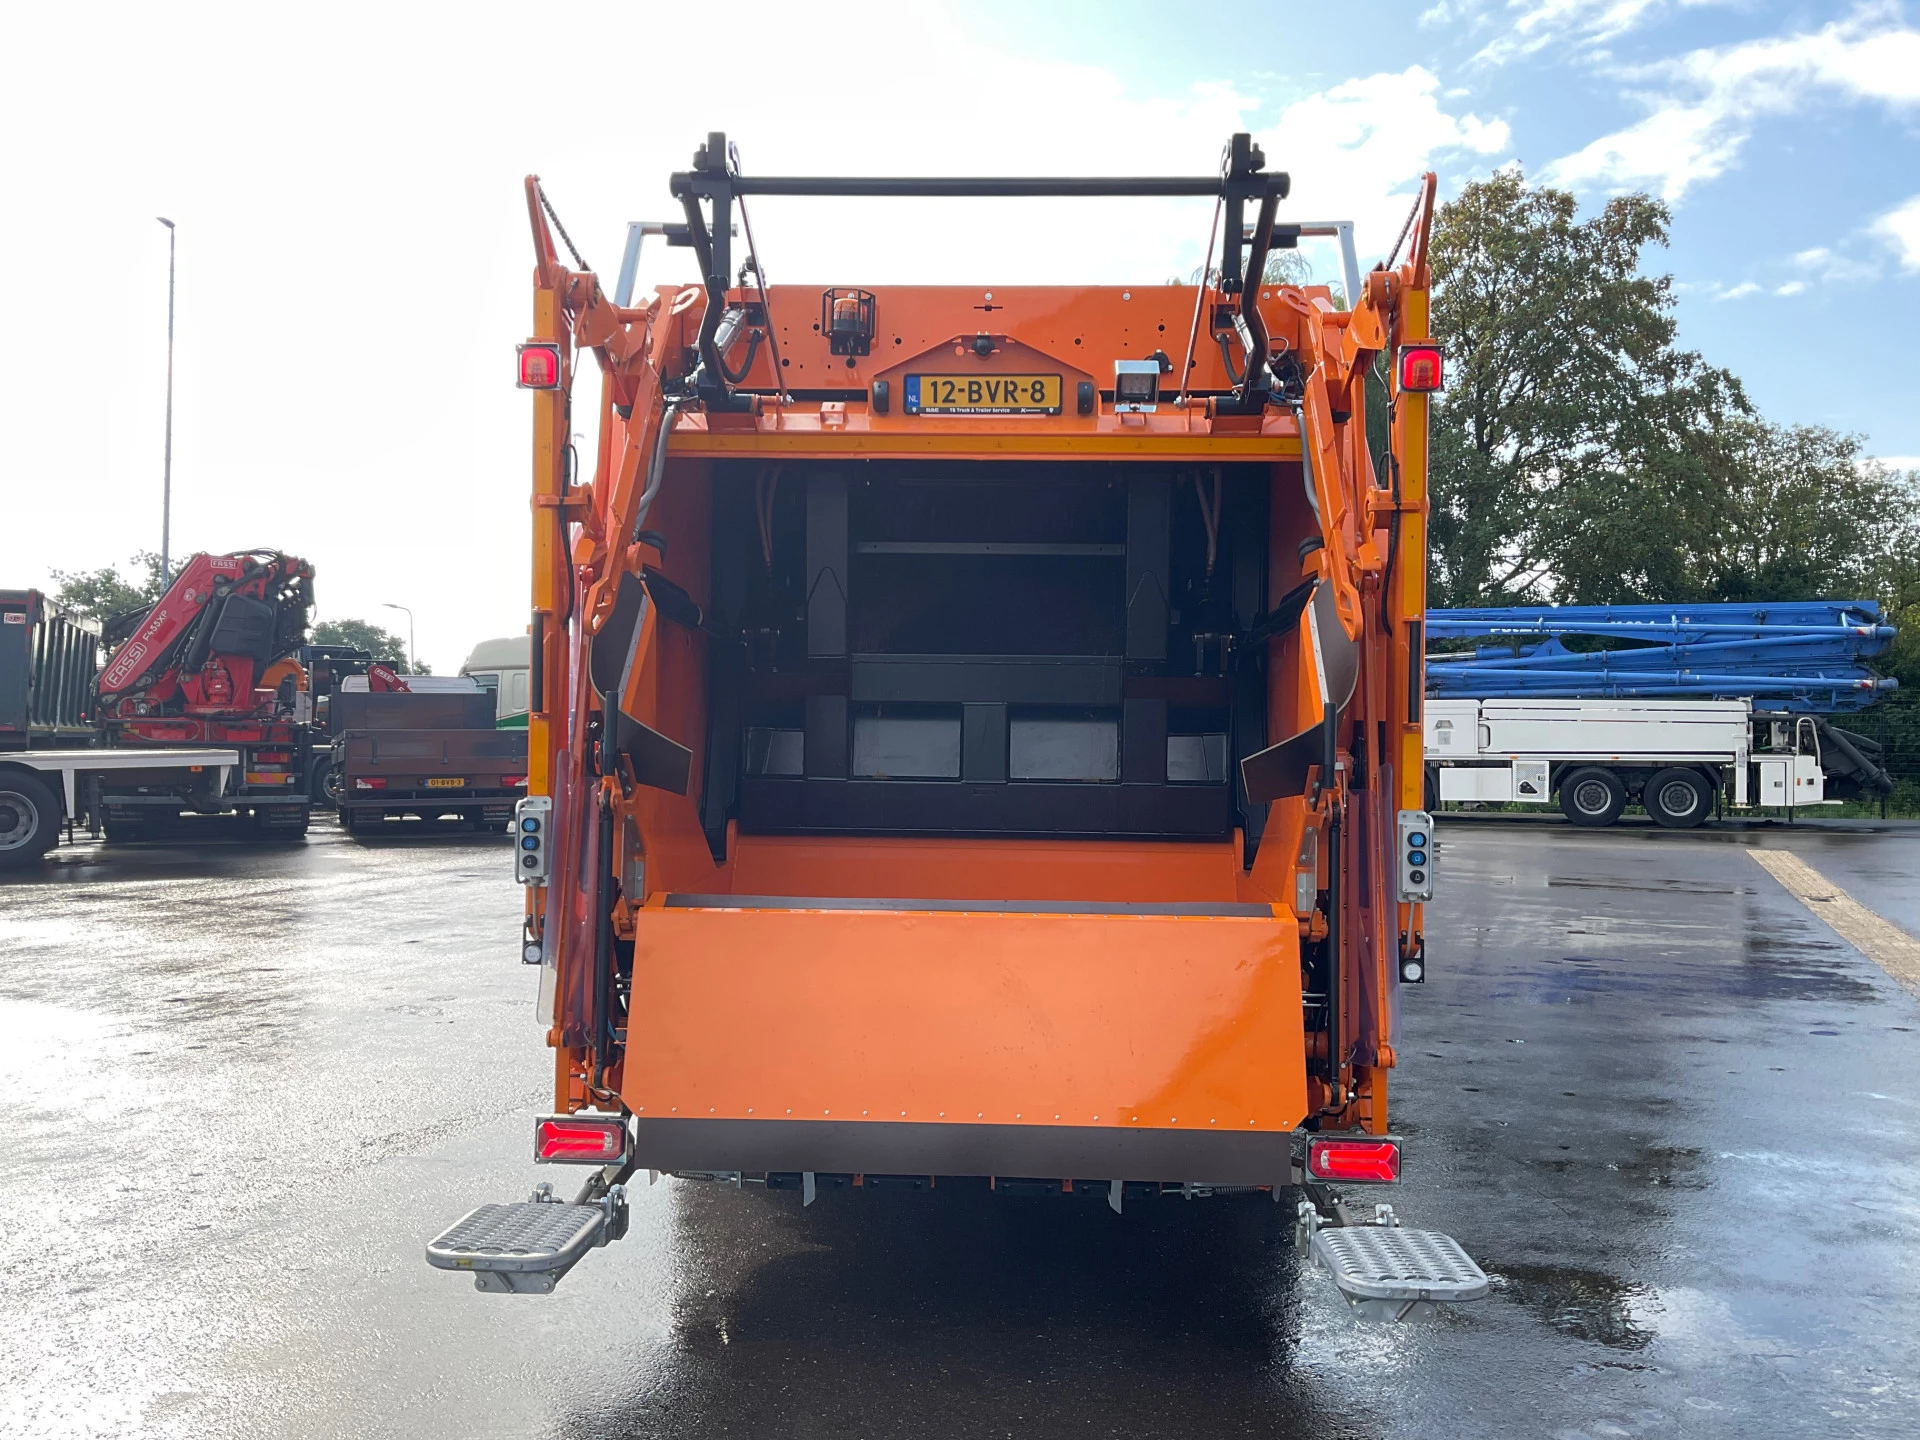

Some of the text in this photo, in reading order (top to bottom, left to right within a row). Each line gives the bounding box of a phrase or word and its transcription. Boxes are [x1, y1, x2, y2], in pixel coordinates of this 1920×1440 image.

[908, 394, 918, 403] NL
[930, 380, 1045, 404] 12-BVR-8
[108, 645, 144, 685] FASSI
[375, 668, 393, 682] FASSI
